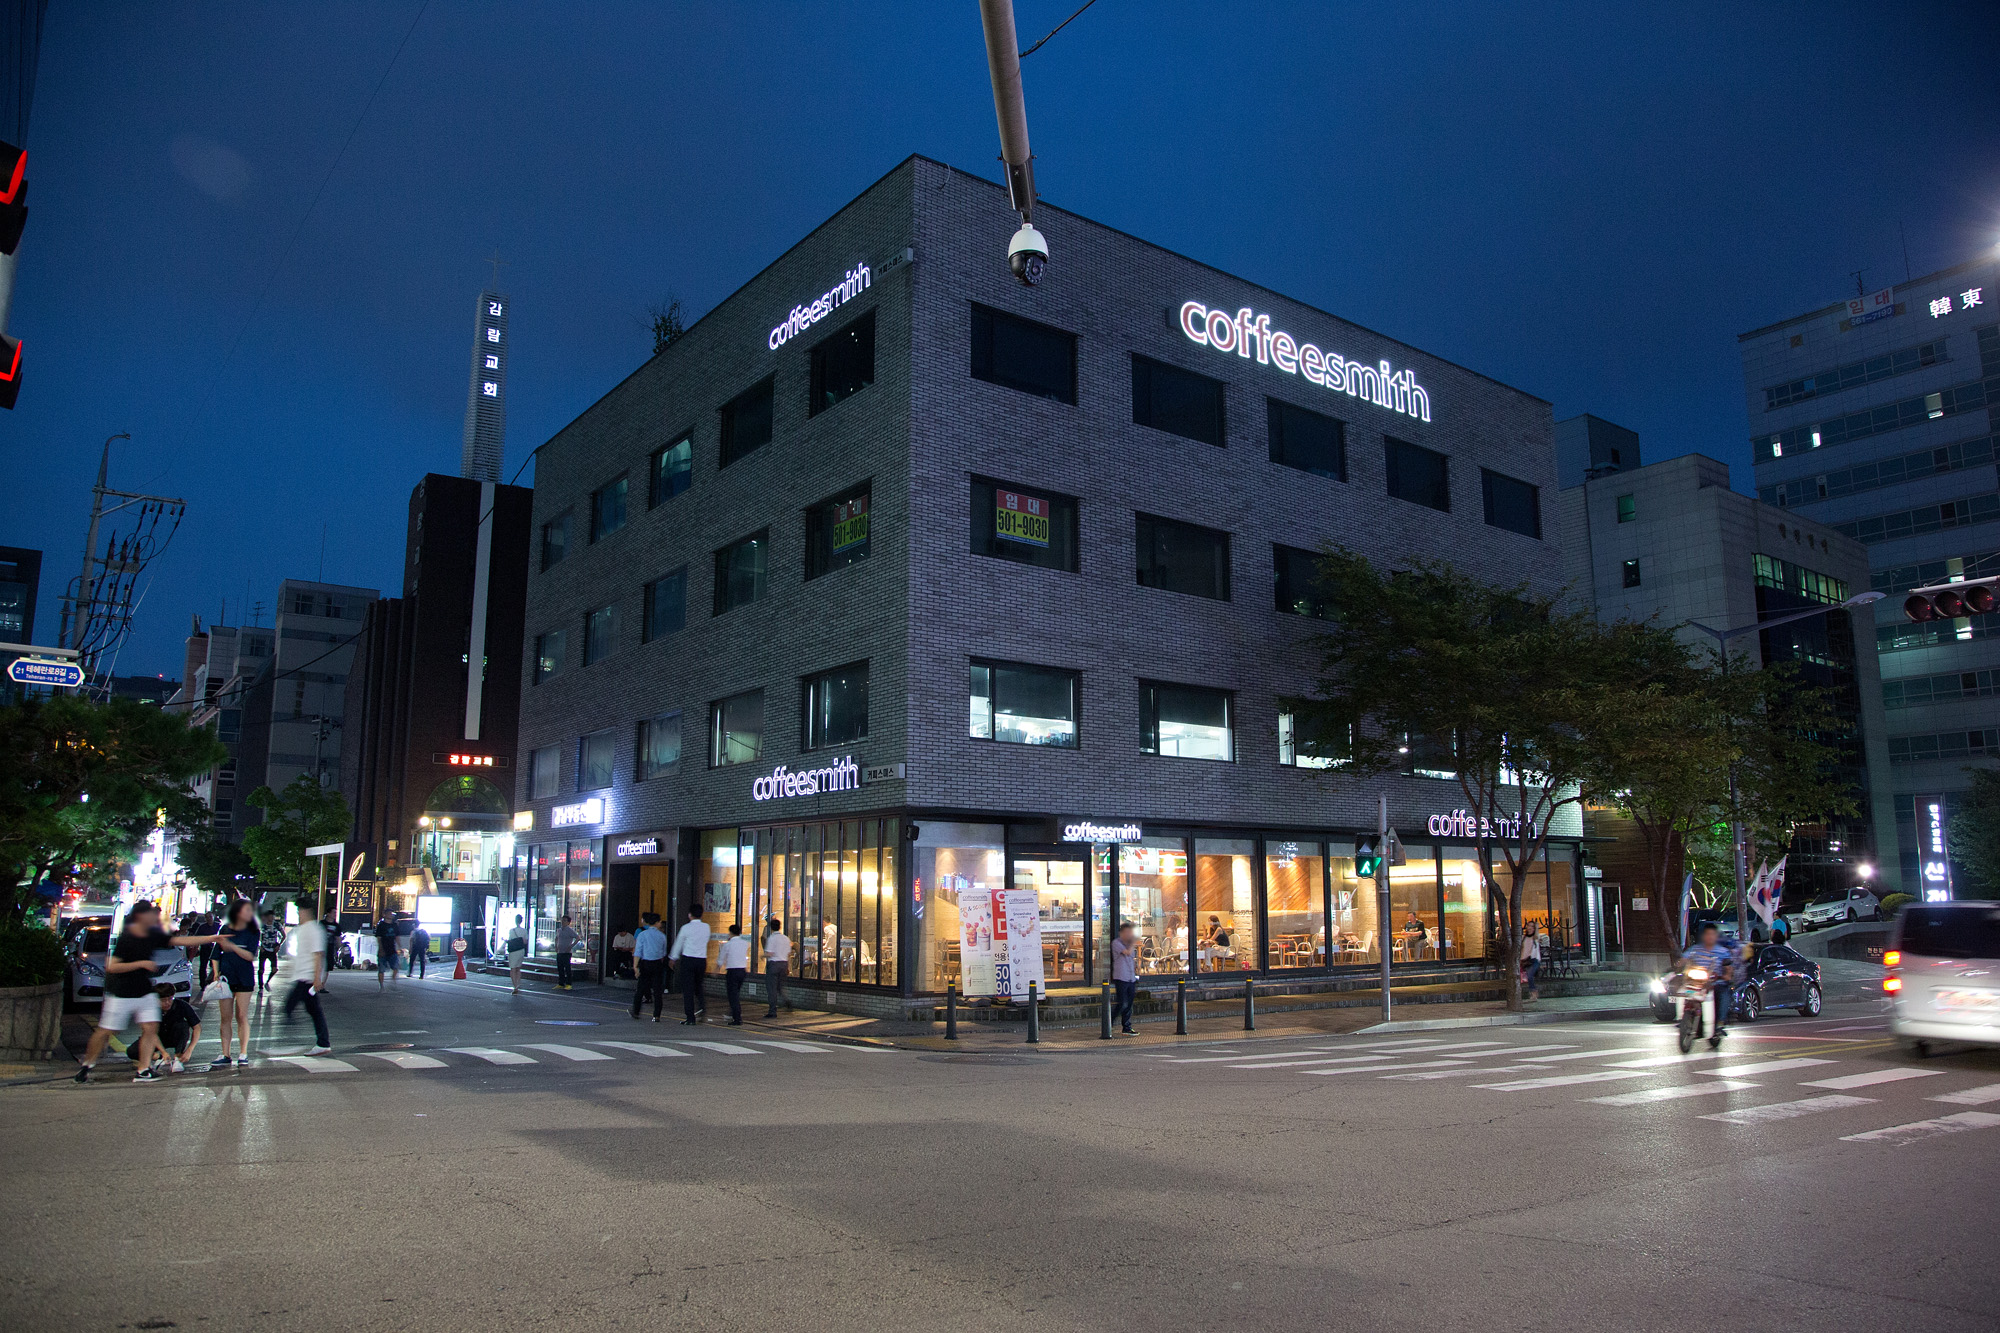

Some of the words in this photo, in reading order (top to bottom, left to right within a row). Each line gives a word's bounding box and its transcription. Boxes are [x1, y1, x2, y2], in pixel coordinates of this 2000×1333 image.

[769, 261, 872, 350] coffeesmith
[1849, 289, 1889, 314] 임대
[1928, 287, 1984, 319] 韓東
[482, 301, 503, 397] 감람교회
[1179, 300, 1432, 423] coffeesmith
[838, 499, 862, 521] 임대
[1006, 493, 1040, 515] 임대
[834, 514, 867, 547] 501-9030
[997, 510, 1048, 540] 501-9030
[26, 665, 67, 677] 테헤란로8길
[68, 672, 78, 680] 25
[753, 755, 859, 800] coffeesmith
[867, 767, 894, 780] 커피스미스
[1064, 821, 1141, 840] coffeesmith
[617, 837, 657, 857] coffeesmith
